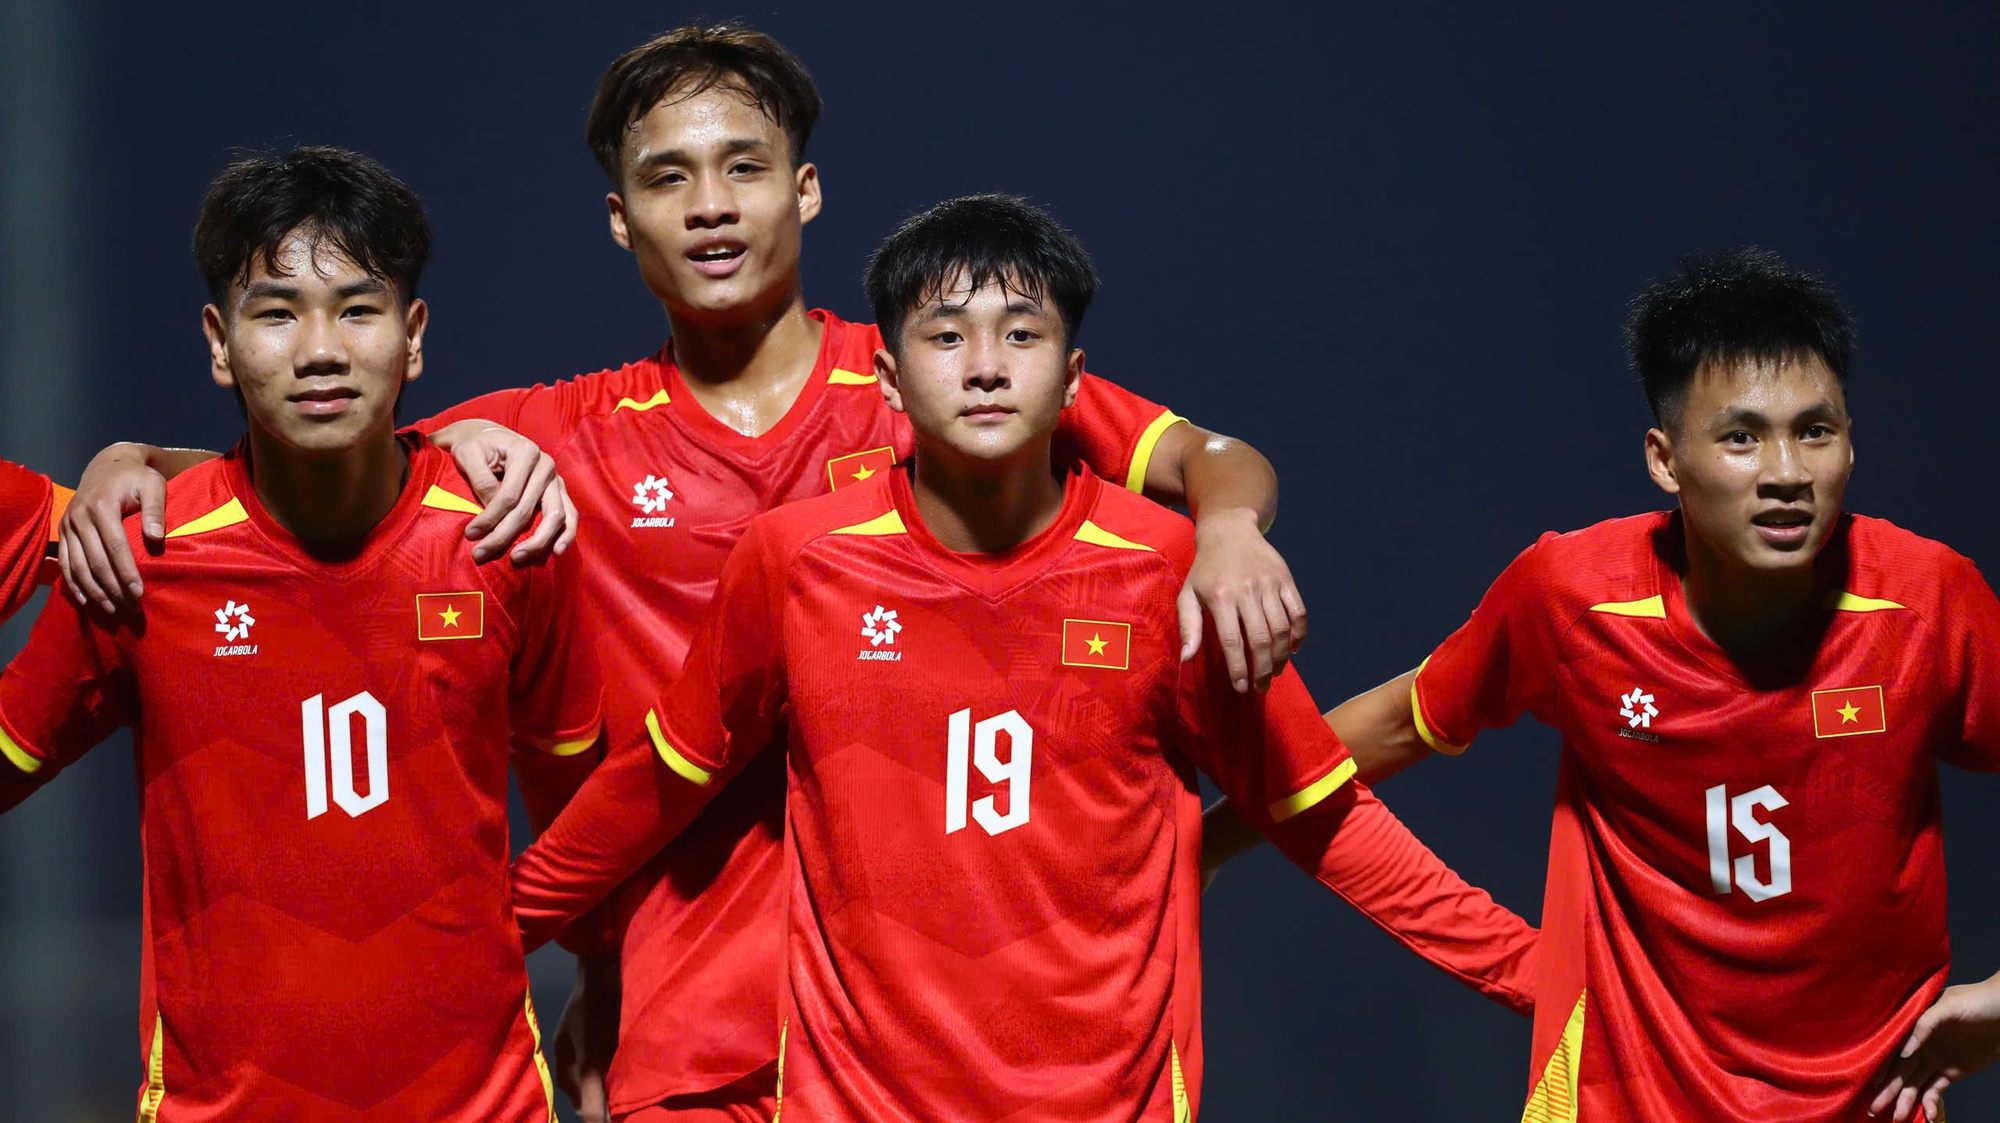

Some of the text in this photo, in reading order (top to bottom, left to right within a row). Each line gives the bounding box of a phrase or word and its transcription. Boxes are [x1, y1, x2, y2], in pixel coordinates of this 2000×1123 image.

[213, 645, 258, 657] JOGARBOLA
[857, 650, 902, 662] JOGARBOLA
[302, 691, 389, 820] 10
[946, 708, 1033, 836] 19
[1705, 783, 1792, 903] 15
